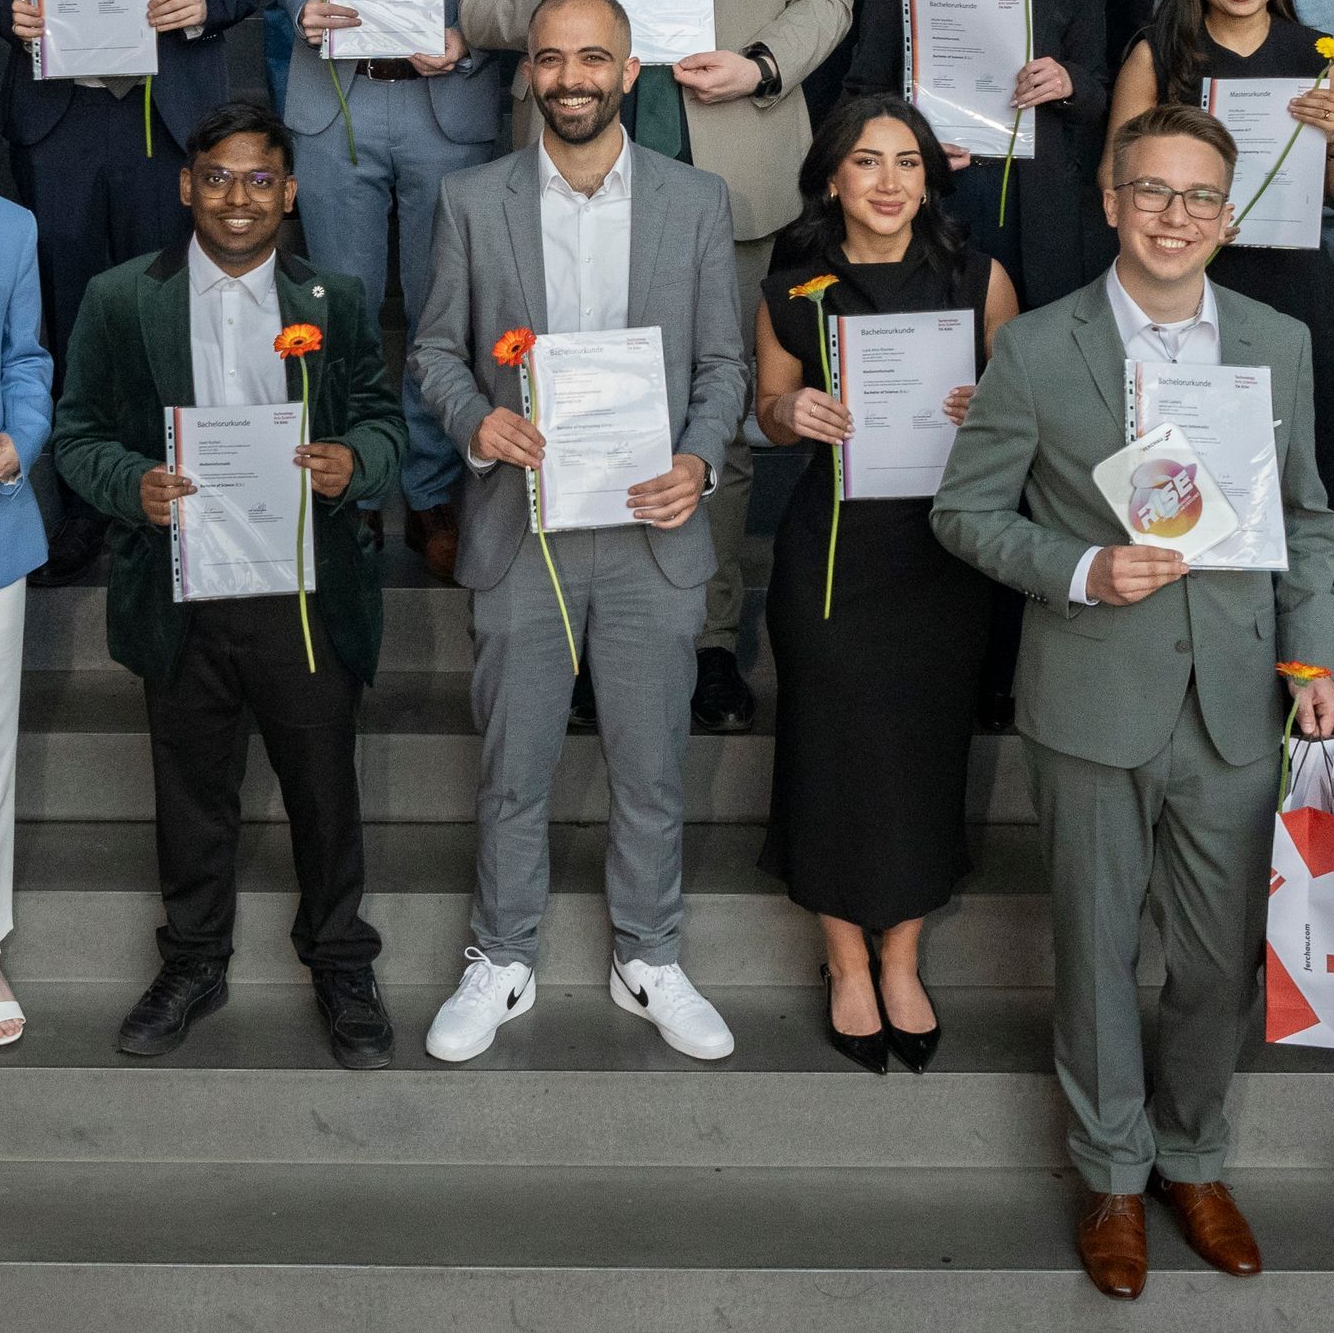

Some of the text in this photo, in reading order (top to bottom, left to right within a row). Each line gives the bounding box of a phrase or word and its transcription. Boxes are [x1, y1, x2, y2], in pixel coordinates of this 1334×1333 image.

[929, 1, 978, 10] Bachelorurkunde
[1230, 90, 1272, 98] Masterurkunde
[861, 326, 915, 336] Bachelorurkunde
[1158, 377, 1212, 388] Bachelorurkunde
[197, 419, 251, 429] Bachelorurkunde
[1303, 923, 1313, 972] ferchau.com
